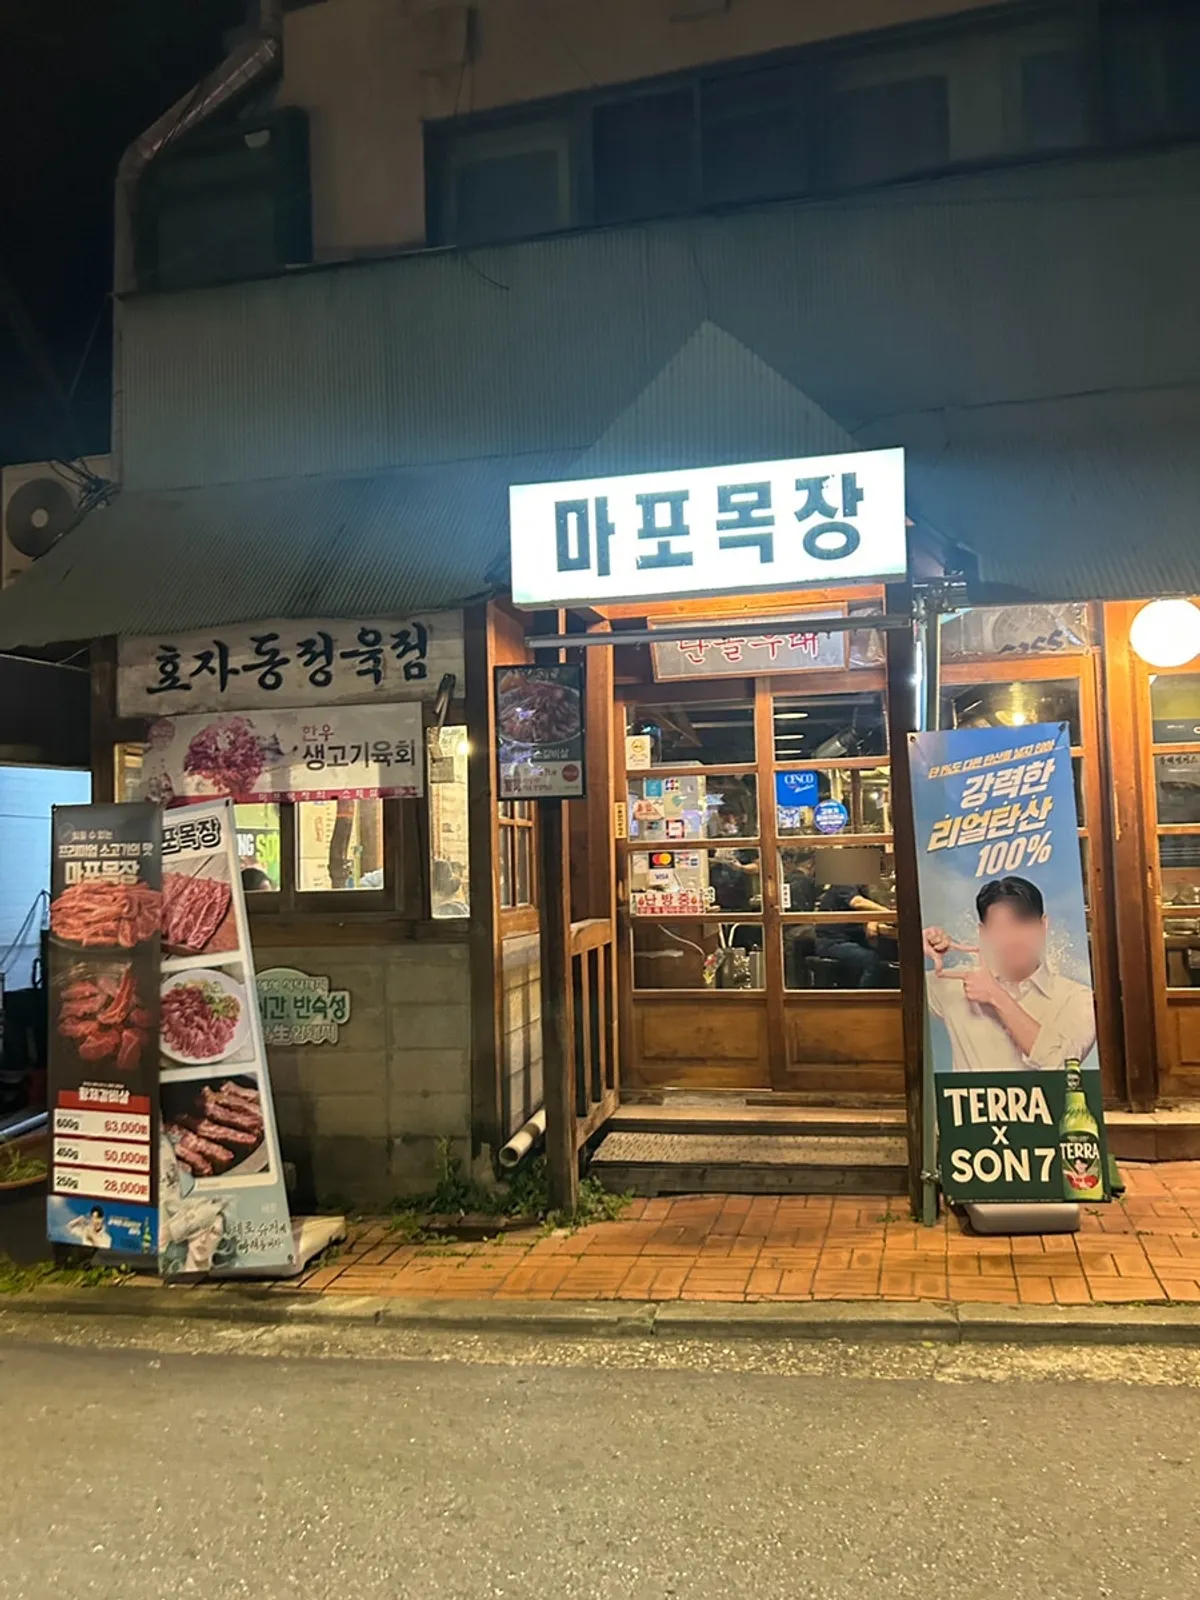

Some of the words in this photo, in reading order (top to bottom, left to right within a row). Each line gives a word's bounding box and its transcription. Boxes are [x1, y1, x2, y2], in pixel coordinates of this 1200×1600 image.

[555, 472, 864, 576] 마포목장
[146, 621, 429, 694] 효자동정육점
[302, 724, 334, 742] 한우
[302, 739, 416, 771] 생고기육회
[960, 758, 1056, 809] 강력한
[926, 796, 1053, 853] 리얼탄산
[58, 843, 98, 858] 프리미엄
[99, 842, 140, 857] 소고기의
[142, 842, 154, 857] 맛
[975, 831, 1052, 878] 100%
[65, 860, 140, 885] 마포목장
[293, 995, 346, 1020] 반숙성
[943, 1086, 1054, 1127] TERRA
[1060, 1142, 1100, 1159] TERRA
